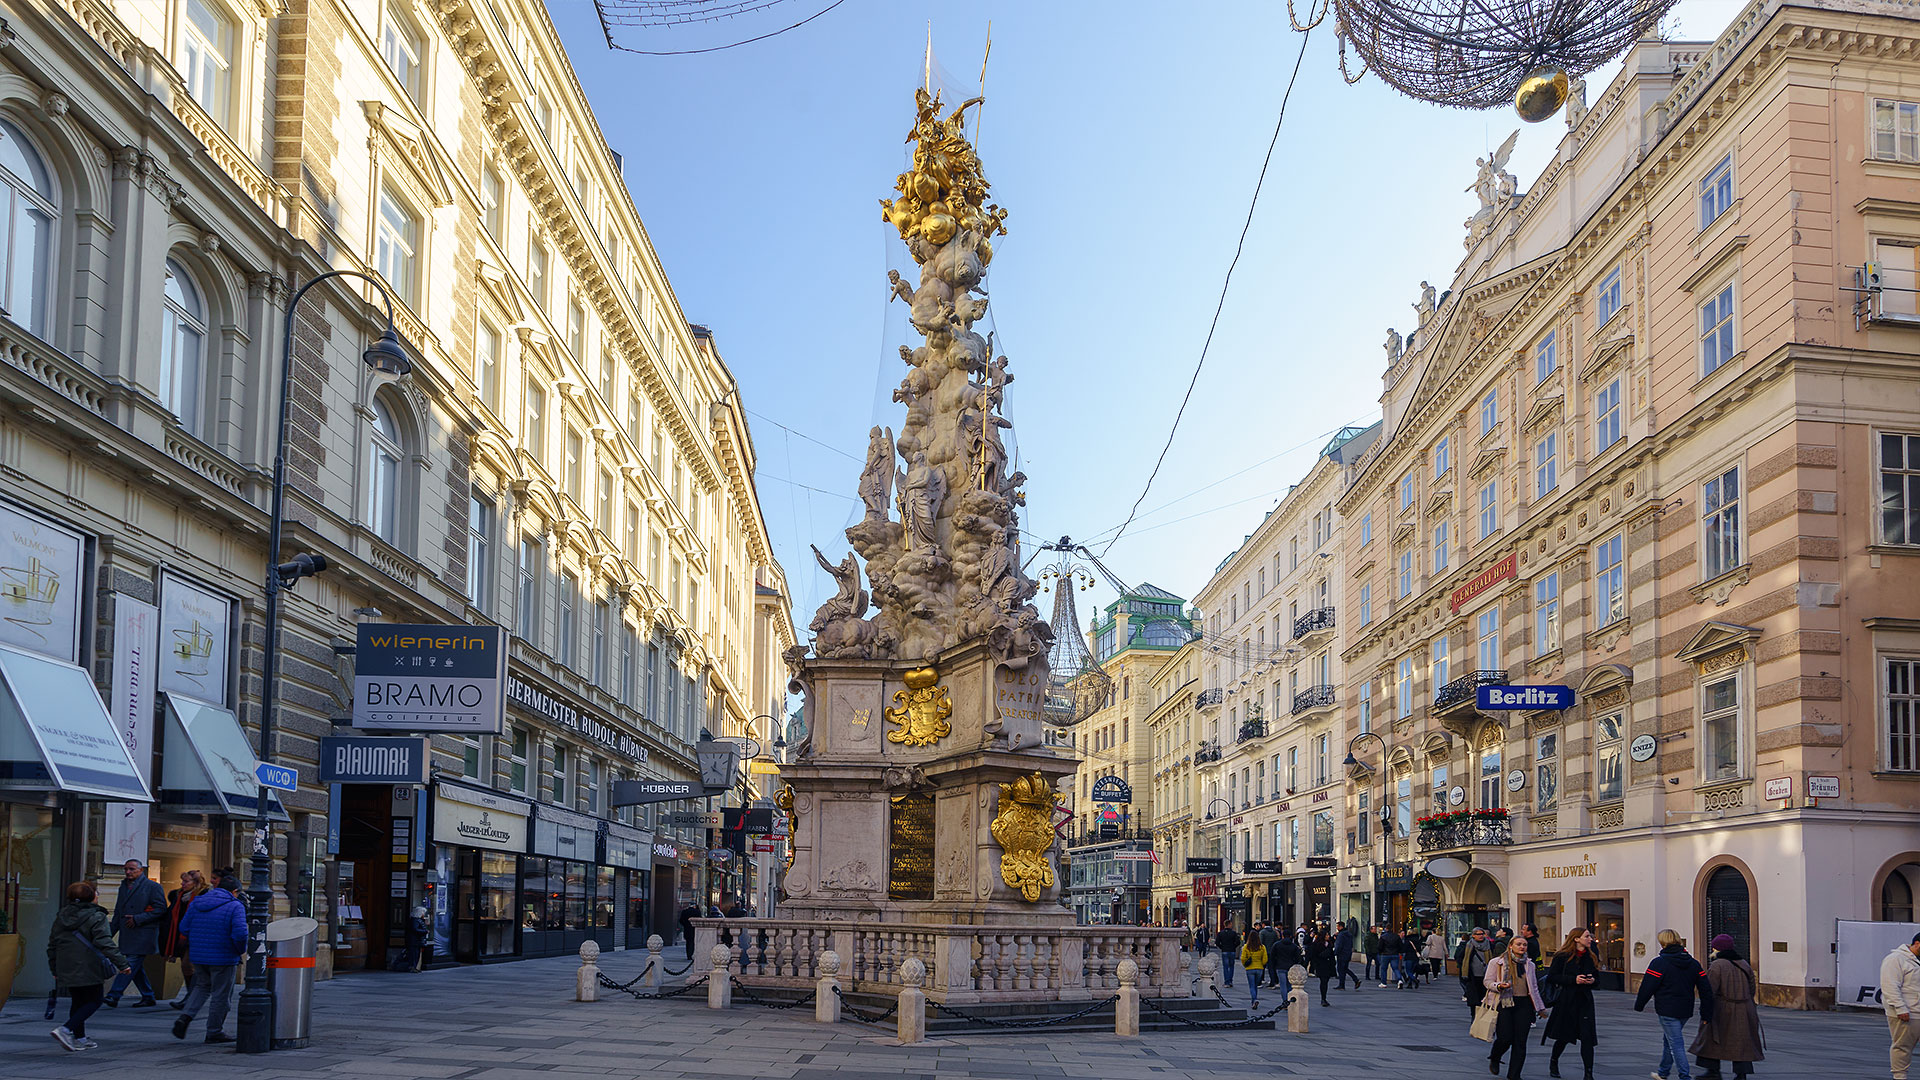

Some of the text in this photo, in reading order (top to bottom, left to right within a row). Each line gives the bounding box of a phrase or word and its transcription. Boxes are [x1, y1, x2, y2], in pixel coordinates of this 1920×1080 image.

[13, 531, 57, 560] VALMONT
[1454, 559, 1512, 604] GENERALI HOF
[370, 634, 485, 650] wienerin
[1005, 669, 1039, 686] DEO
[128, 646, 141, 730] STRUBELL
[367, 682, 482, 708] BRAMO
[1489, 688, 1558, 704] Berlitz
[1000, 689, 1040, 704] PATRI
[371, 714, 477, 722] COIFFEUR
[1000, 706, 1041, 721] CREATORI
[620, 735, 648, 763] HÜBNER
[1632, 742, 1653, 753] KNIZE
[267, 768, 282, 784] WC
[641, 785, 689, 793] HÜBNER
[1768, 786, 1788, 796] Graben
[1811, 782, 1838, 791] Bräuner-
[1313, 791, 1329, 803] LISKA
[1277, 802, 1290, 813] LISKA
[675, 815, 712, 824] swatch
[1543, 863, 1597, 879] HELDWEIN
[1193, 875, 1216, 897] LISKA
